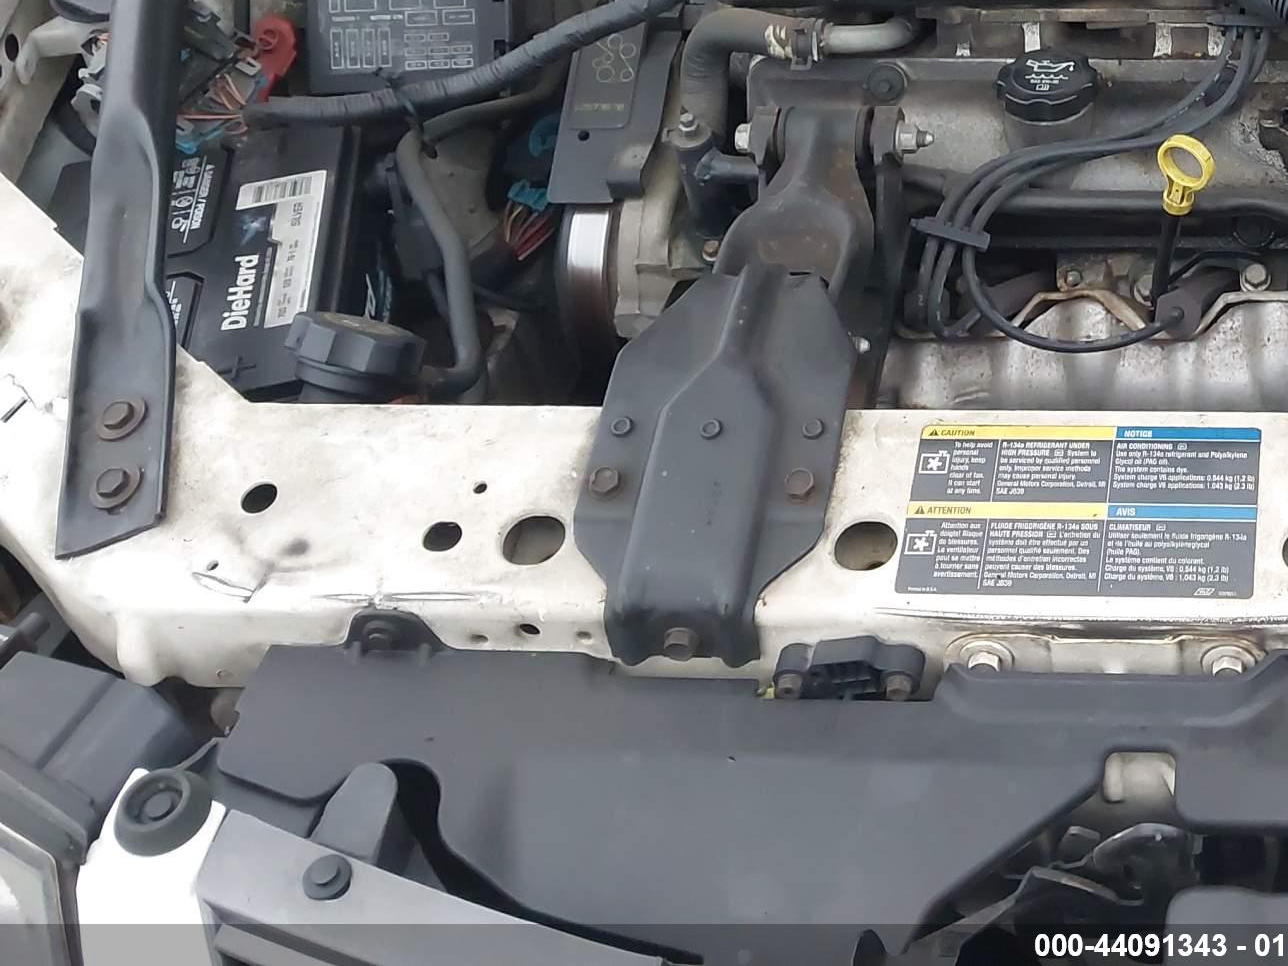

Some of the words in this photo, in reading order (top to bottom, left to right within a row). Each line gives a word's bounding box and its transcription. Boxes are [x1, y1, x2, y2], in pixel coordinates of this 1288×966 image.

[221, 254, 260, 331] DieHard
[1124, 430, 1153, 438] NOTICE
[927, 506, 971, 514] ATTENTION
[1116, 508, 1136, 516] AVIS
